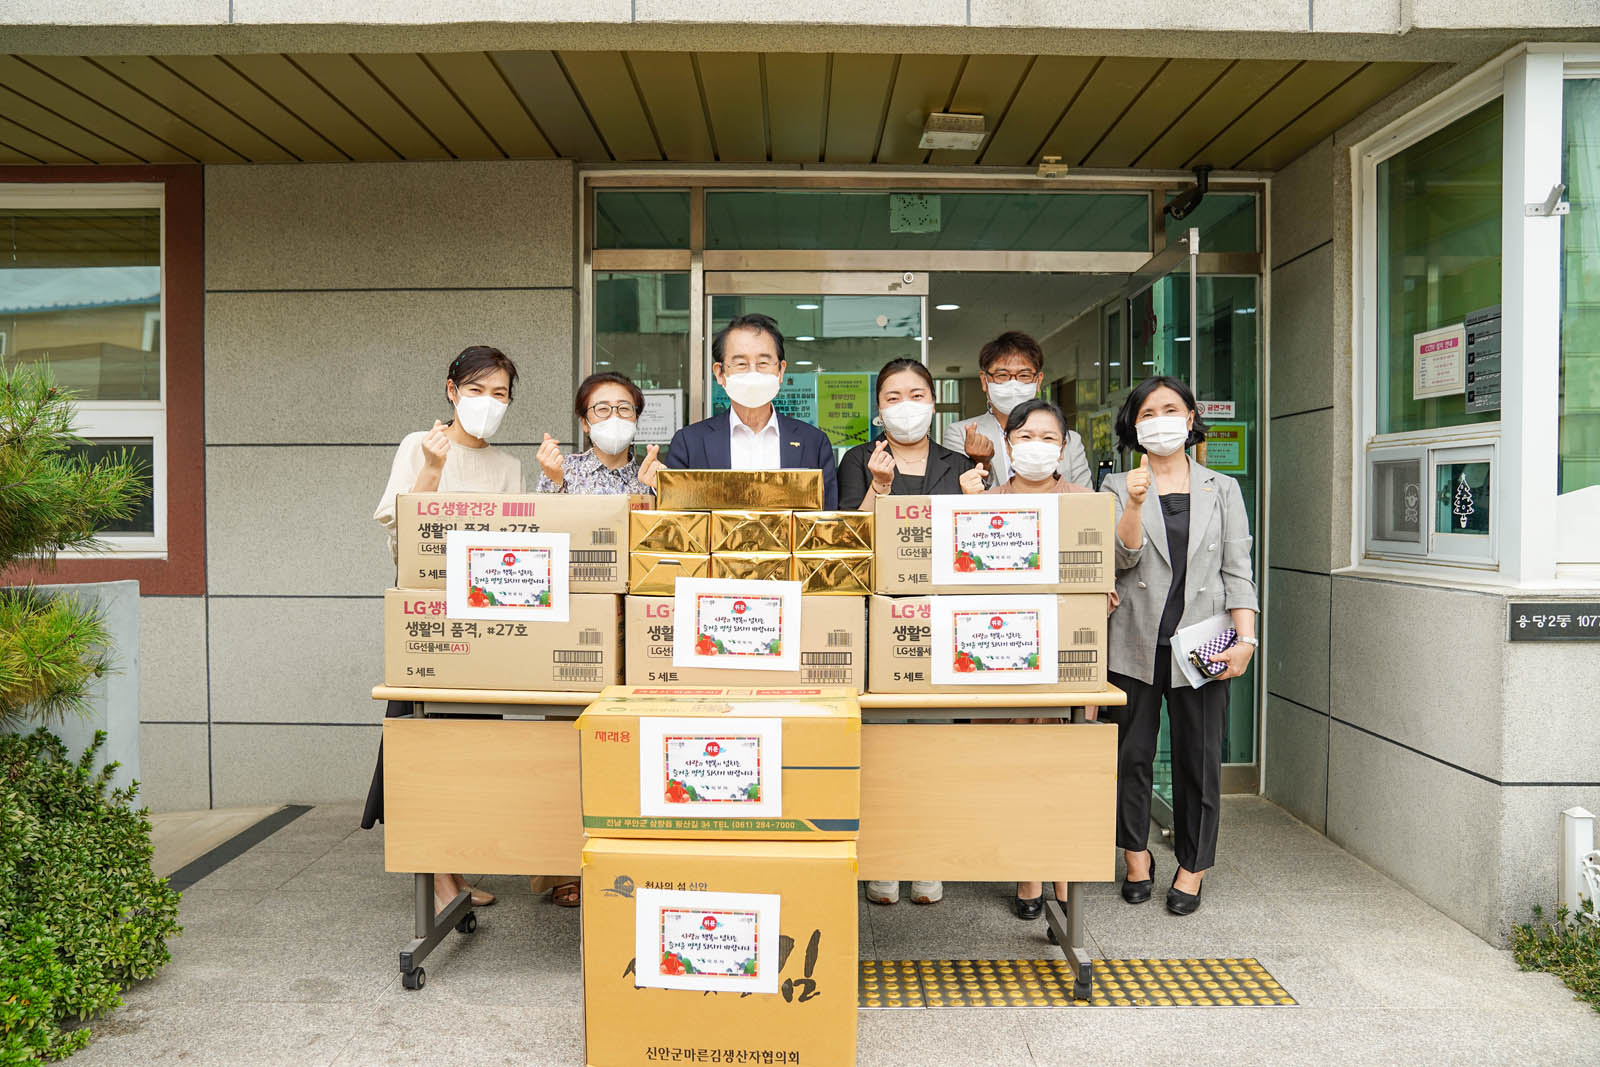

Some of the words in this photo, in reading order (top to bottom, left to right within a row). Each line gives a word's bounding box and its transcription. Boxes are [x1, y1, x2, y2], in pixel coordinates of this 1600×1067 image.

[419, 570, 426, 578] 5
[428, 569, 447, 579] 세트
[898, 574, 905, 582] 5
[908, 573, 928, 584] 세트
[646, 604, 674, 618] LG
[1516, 614, 1572, 628] 용당2동
[405, 622, 445, 638] 생활의
[450, 622, 482, 638] 품격,
[487, 623, 528, 637] #27호
[407, 668, 413, 676] 5
[416, 666, 436, 677] 세트
[648, 672, 655, 680] 5
[658, 672, 679, 682] 세트
[894, 672, 900, 681] 5
[904, 672, 924, 682] 세트
[732, 821, 752, 829] (061)
[756, 821, 795, 829] 284-7000
[646, 1046, 800, 1064] 신안군마른김생산자협의회
